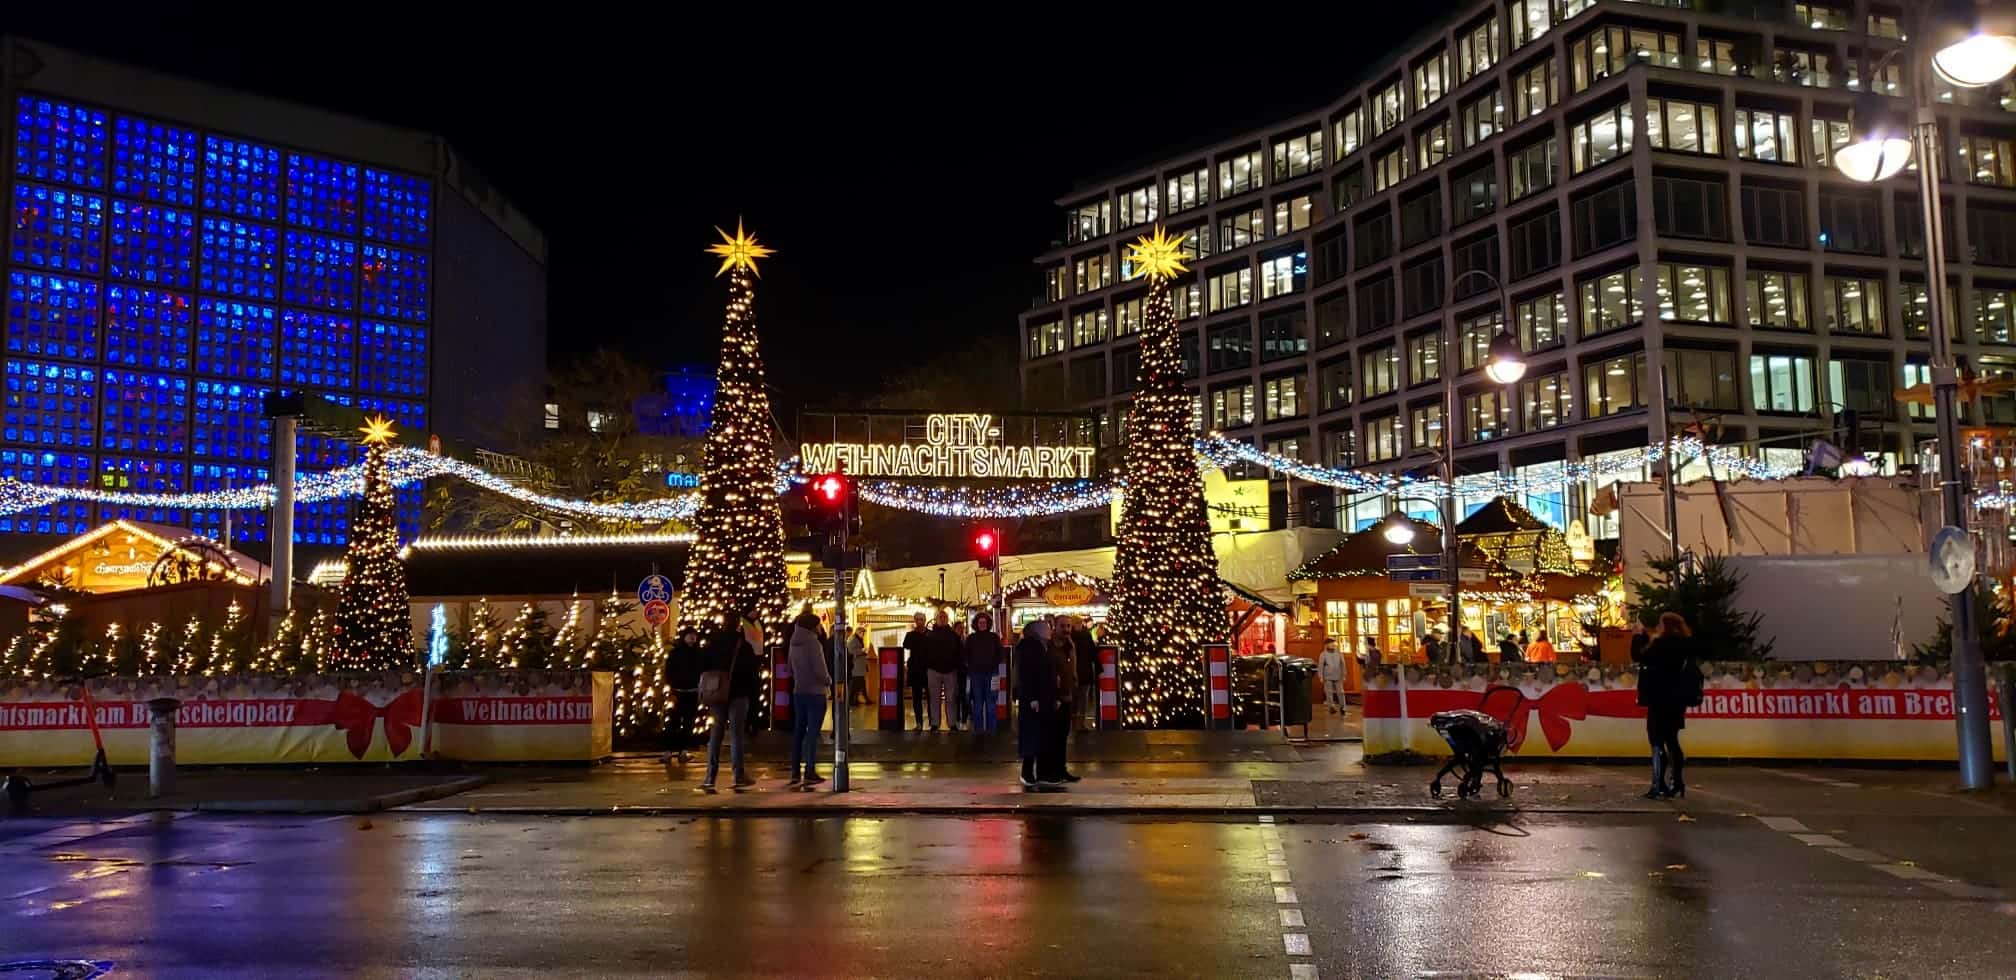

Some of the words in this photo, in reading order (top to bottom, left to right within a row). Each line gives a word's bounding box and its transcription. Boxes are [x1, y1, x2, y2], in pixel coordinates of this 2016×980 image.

[926, 413, 1000, 446] CITY-
[801, 443, 1095, 478] WEIHNACHTSMARKT
[96, 705, 125, 726] am
[1859, 694, 1897, 715] am
